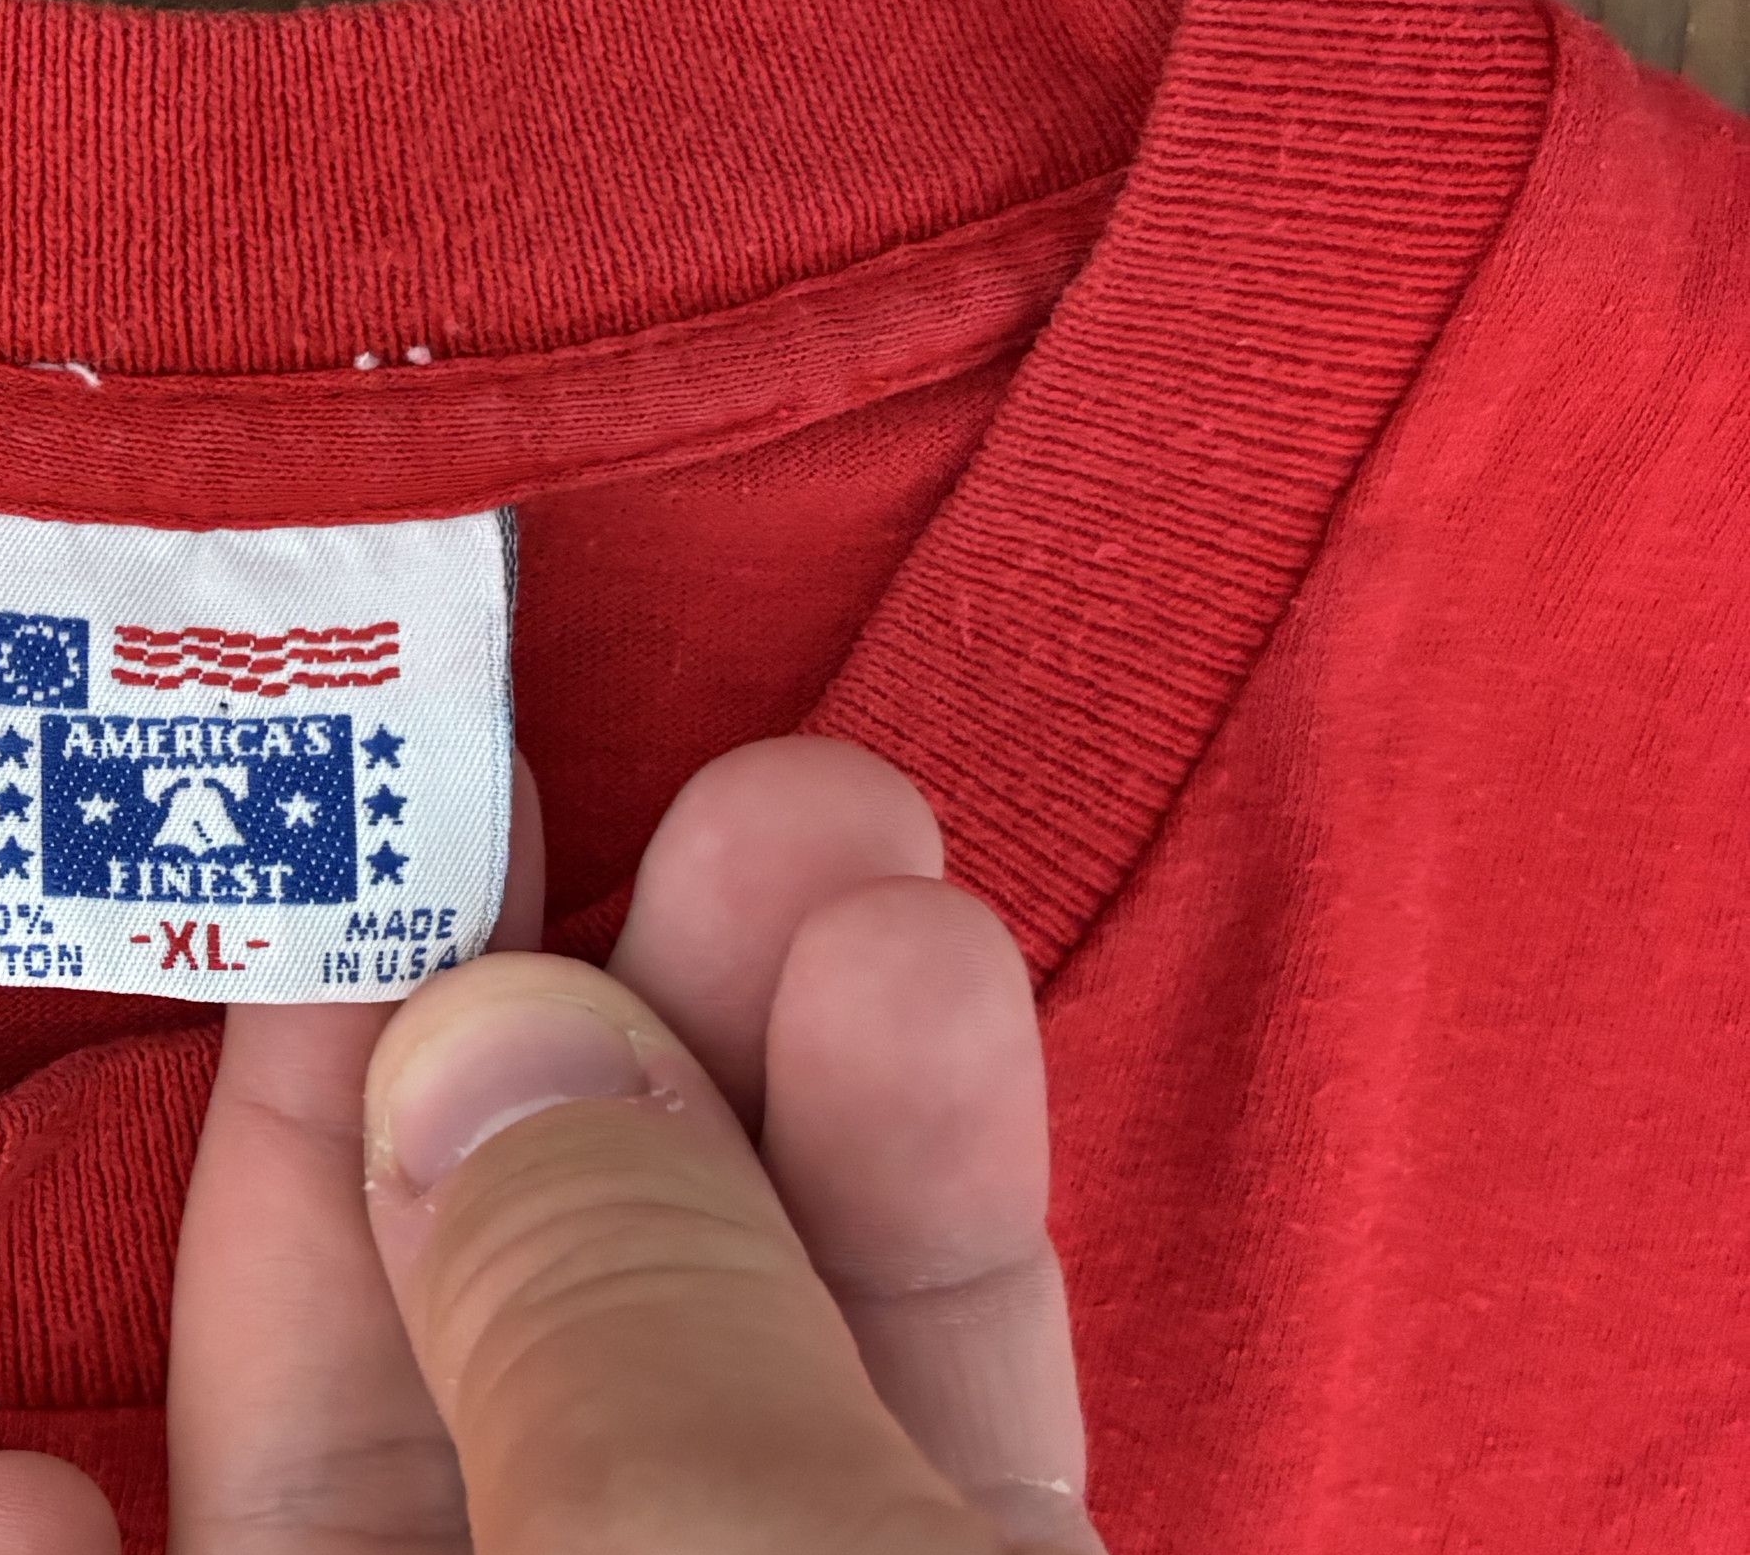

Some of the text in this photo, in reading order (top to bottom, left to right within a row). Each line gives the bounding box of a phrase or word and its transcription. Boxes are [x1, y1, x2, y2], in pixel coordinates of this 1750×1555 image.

[63, 722, 331, 759] AMERICA'S
[108, 858, 293, 897] FINEST
[345, 908, 457, 942] MADE
[323, 952, 360, 983] IN
